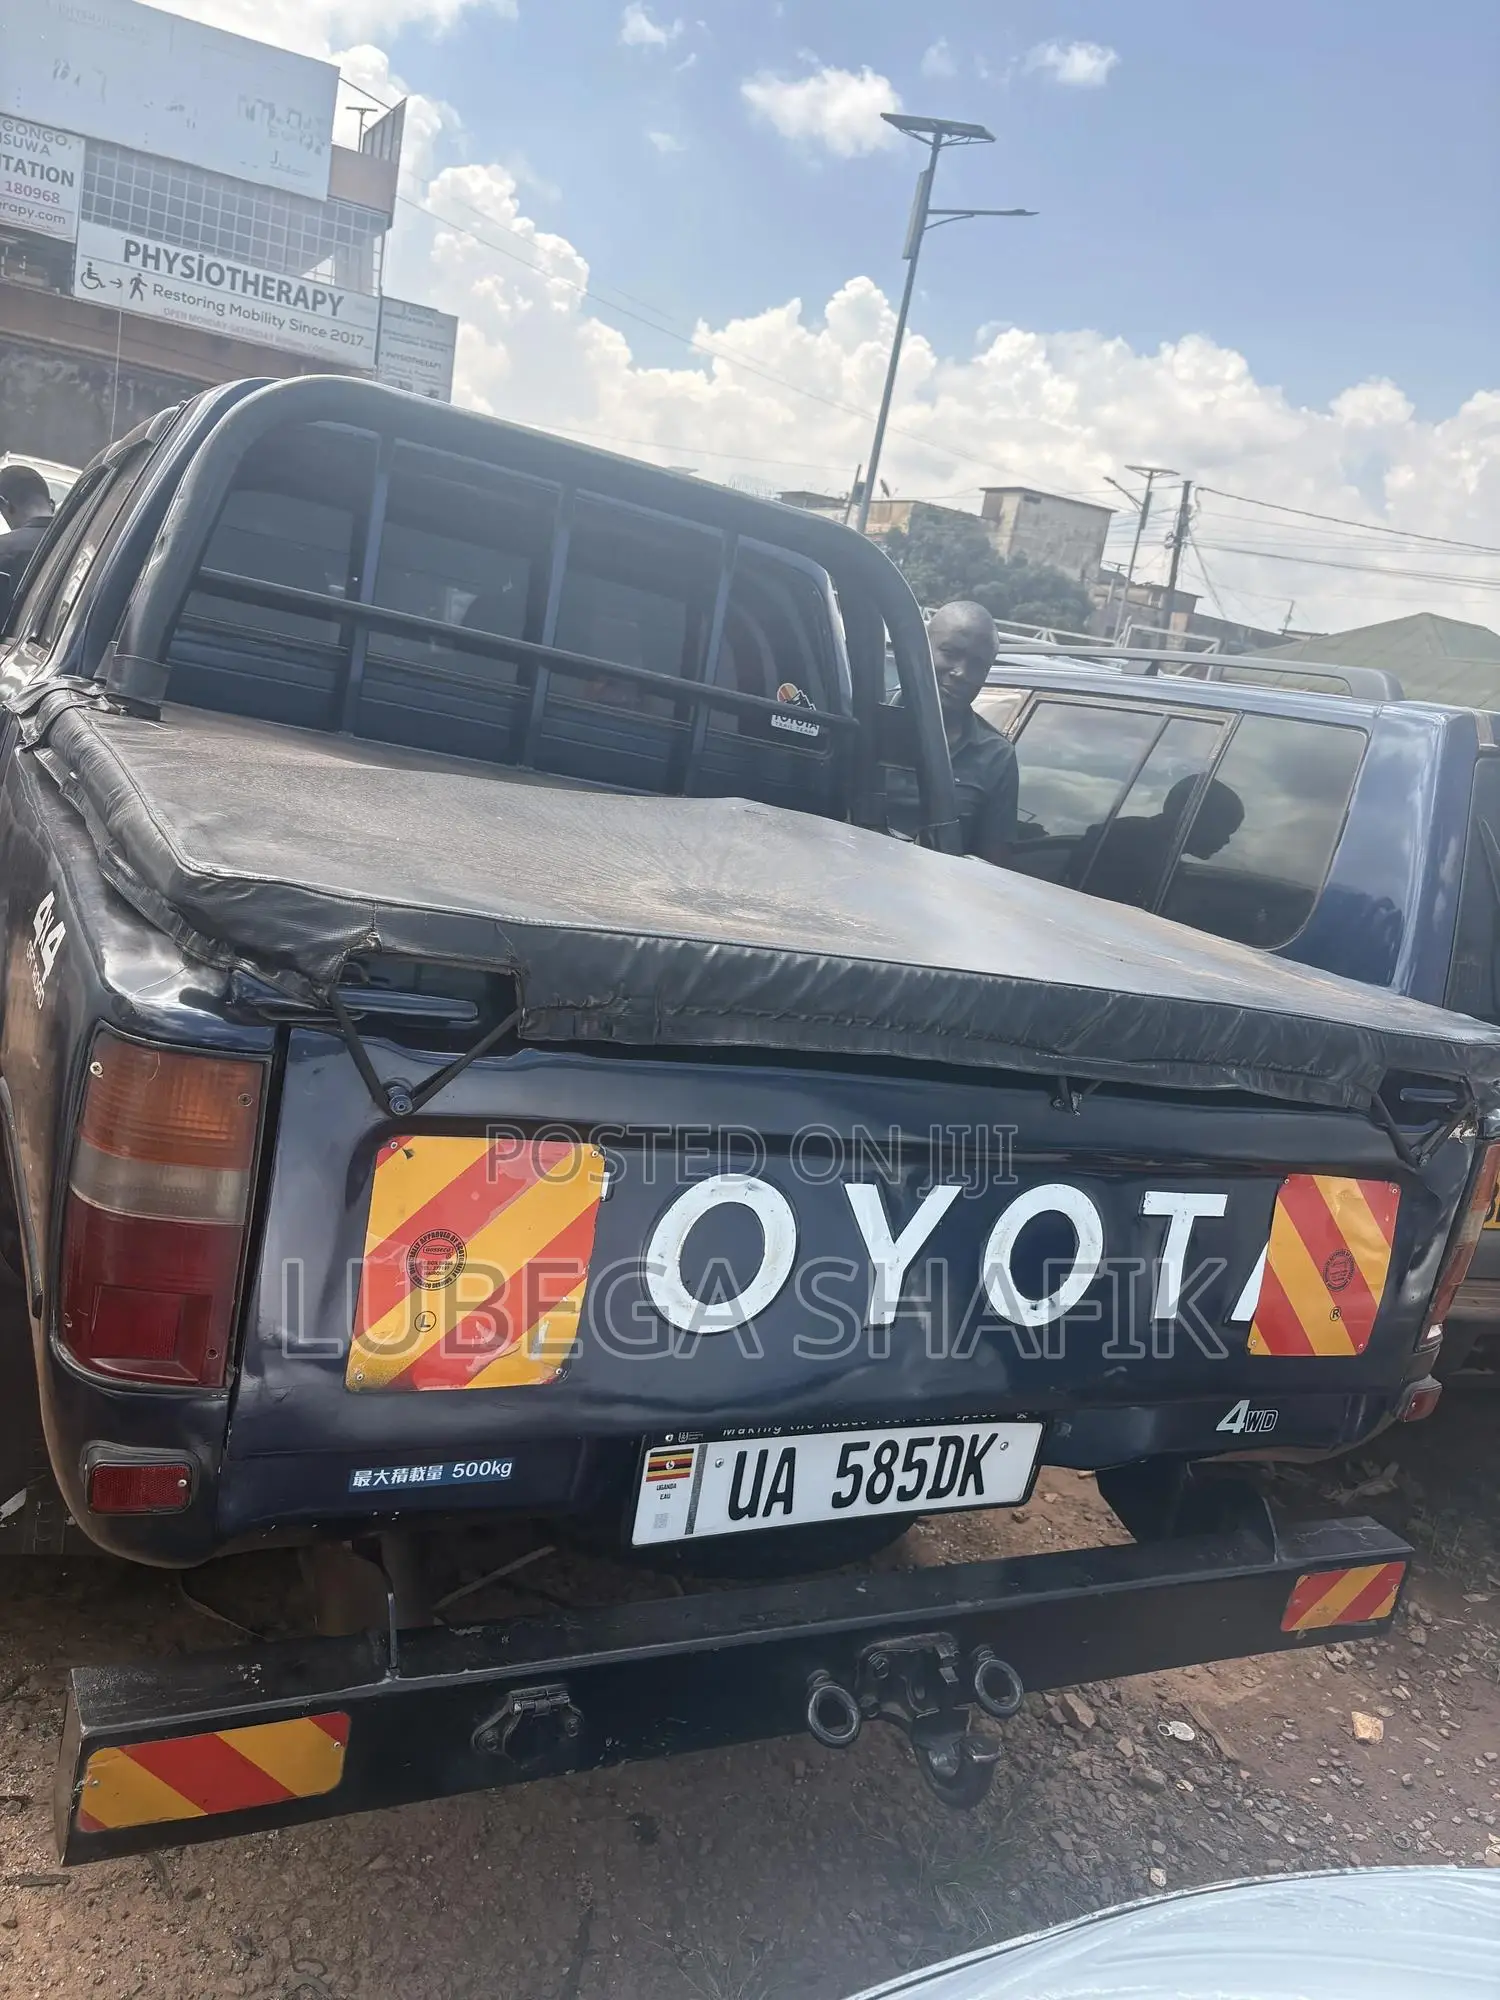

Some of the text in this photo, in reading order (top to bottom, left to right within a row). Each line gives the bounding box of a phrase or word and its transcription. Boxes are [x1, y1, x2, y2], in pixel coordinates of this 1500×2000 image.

[0, 131, 51, 157] SUWA
[0, 153, 75, 188] TATION
[5, 180, 60, 205] 180968
[152, 283, 226, 317] Restoring
[229, 303, 285, 330] Mobility
[289, 318, 328, 338] Since
[601, 1172, 1269, 1335] OYOT
[1216, 1400, 1279, 1433] 4WD
[352, 1460, 513, 1488] 最大積載量 500kg
[728, 1446, 797, 1521] UA
[831, 1433, 999, 1509] 585DK
